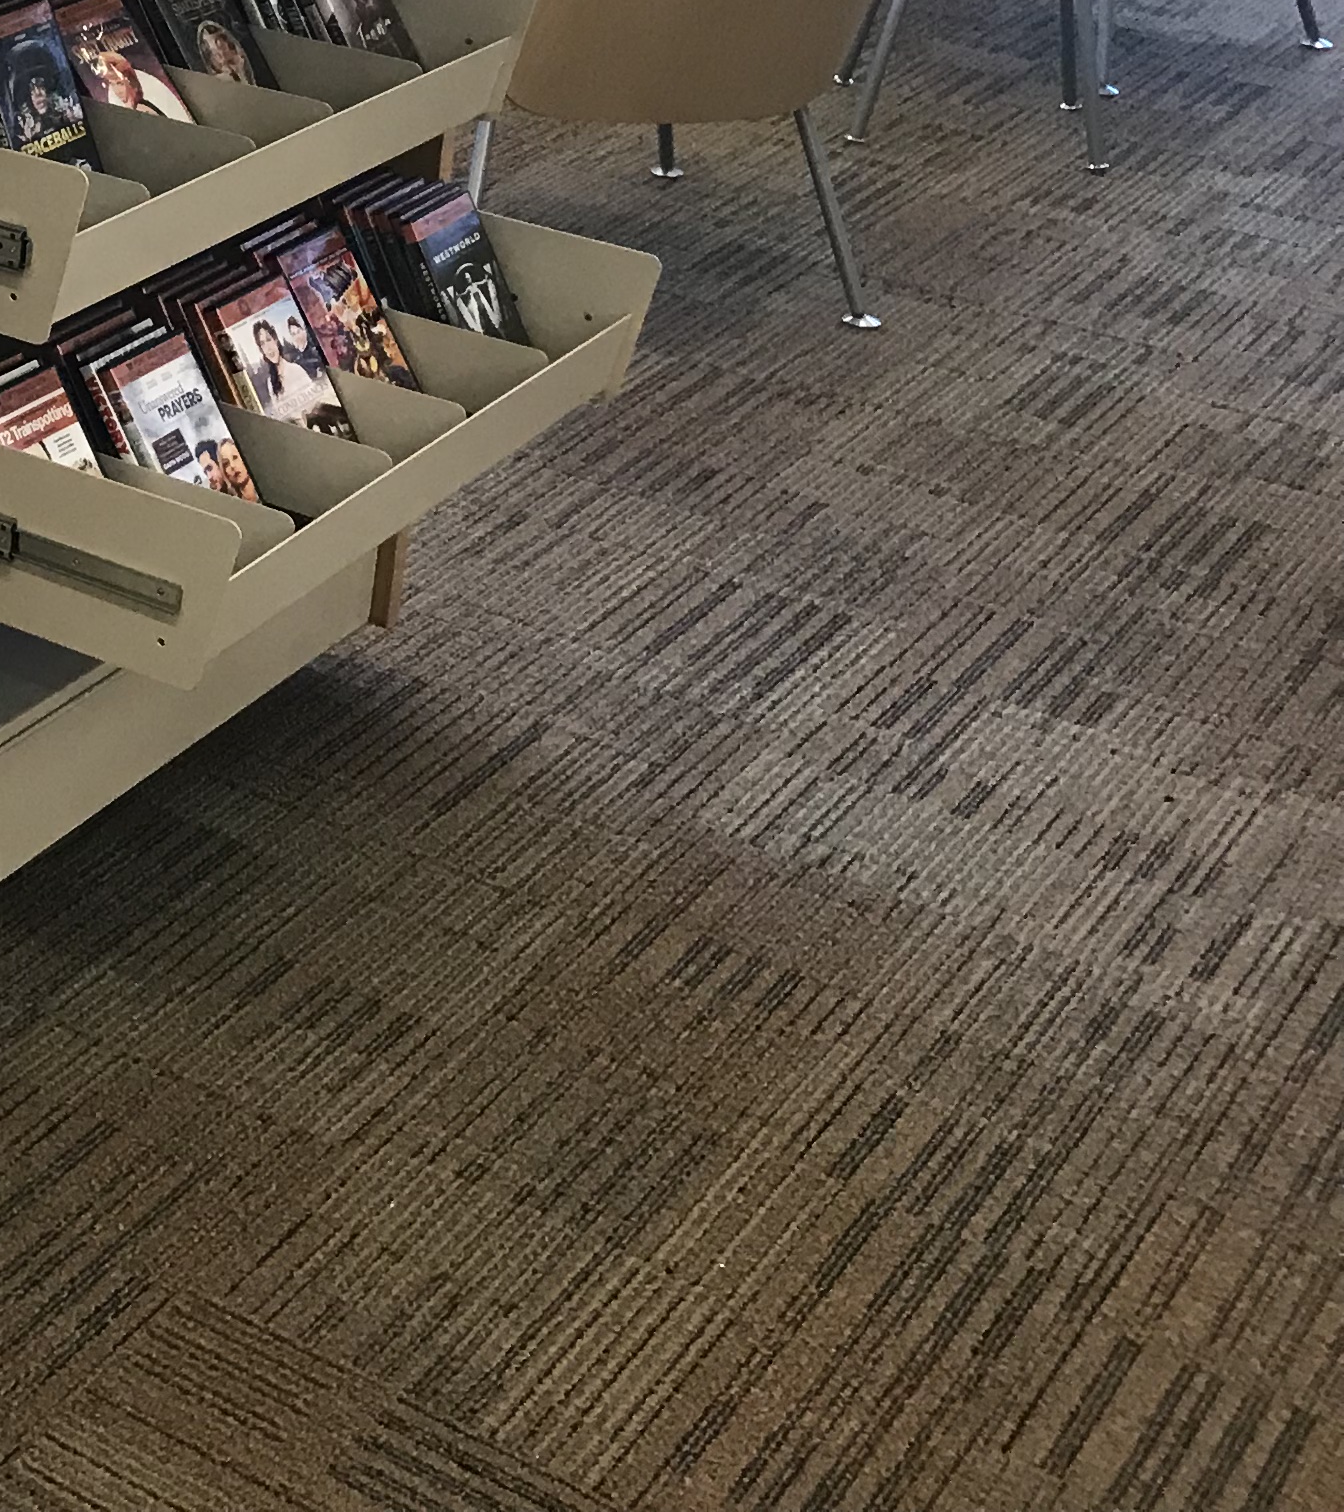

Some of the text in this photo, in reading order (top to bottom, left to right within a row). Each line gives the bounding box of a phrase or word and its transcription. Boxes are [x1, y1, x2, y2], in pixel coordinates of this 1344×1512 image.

[21, 121, 87, 157] SPACEBALLS
[432, 232, 482, 265] WESTWORLD
[12, 401, 73, 439] Trainspotting
[157, 388, 204, 423] PRAYERS
